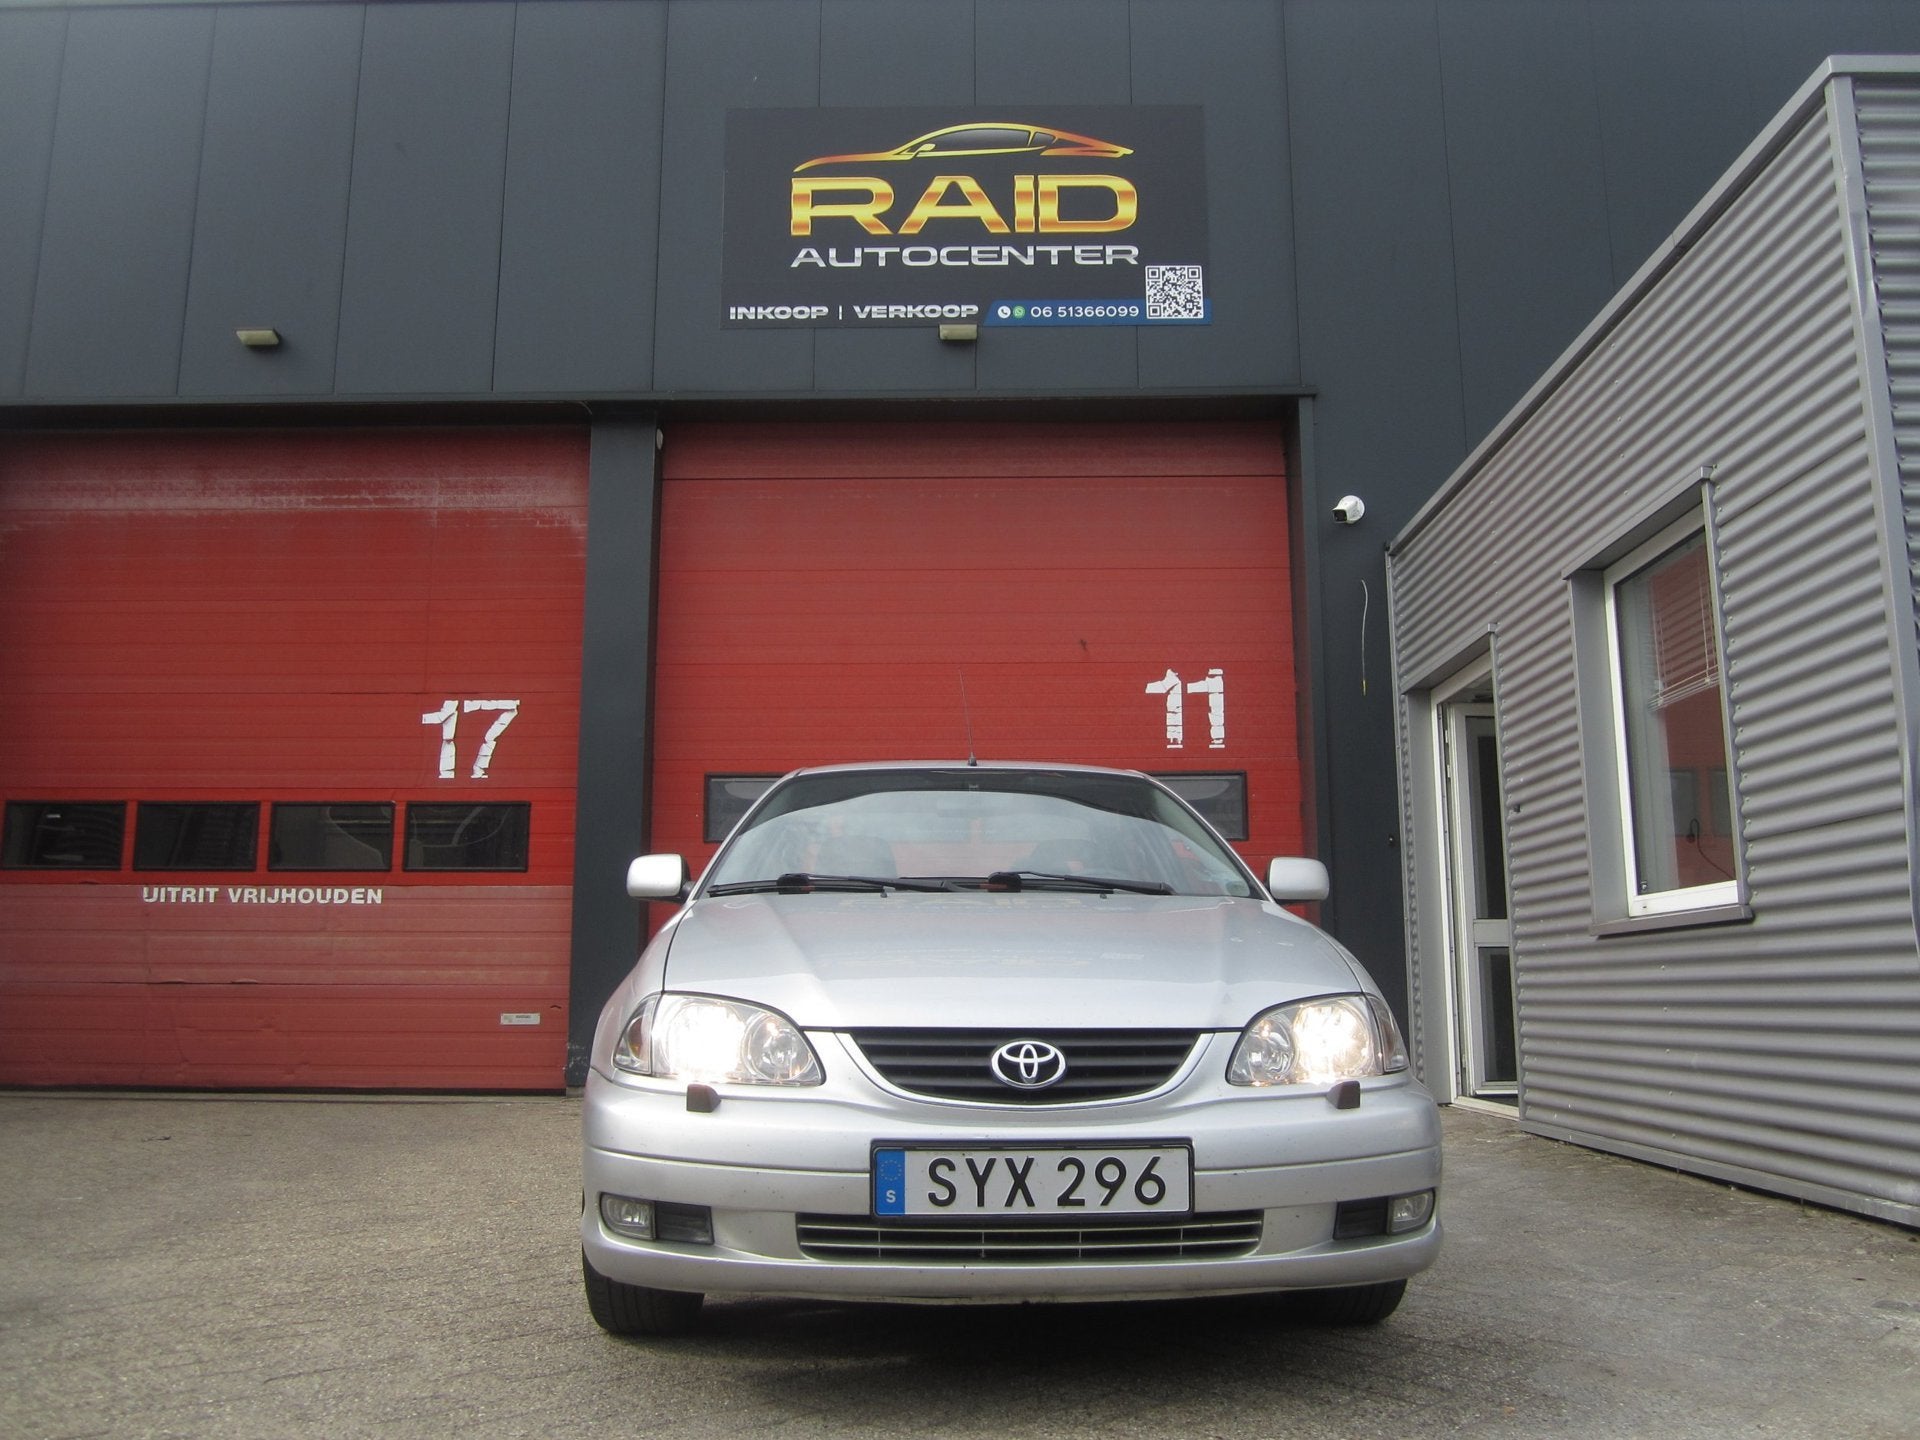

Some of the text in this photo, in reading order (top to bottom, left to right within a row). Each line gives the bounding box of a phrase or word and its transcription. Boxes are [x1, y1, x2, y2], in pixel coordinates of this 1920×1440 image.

[790, 174, 1138, 236] RAID
[790, 245, 1140, 268] AUTOCENTER
[729, 305, 829, 320] INKOOP
[853, 304, 979, 319] VERKOOP
[1030, 305, 1140, 318] 06 51366099
[1145, 668, 1225, 749] 11
[422, 699, 520, 778] 17
[143, 886, 383, 904] UITRIT VRIJHOUDEN
[928, 1156, 1166, 1207] SYX 296
[885, 1189, 897, 1204] S
